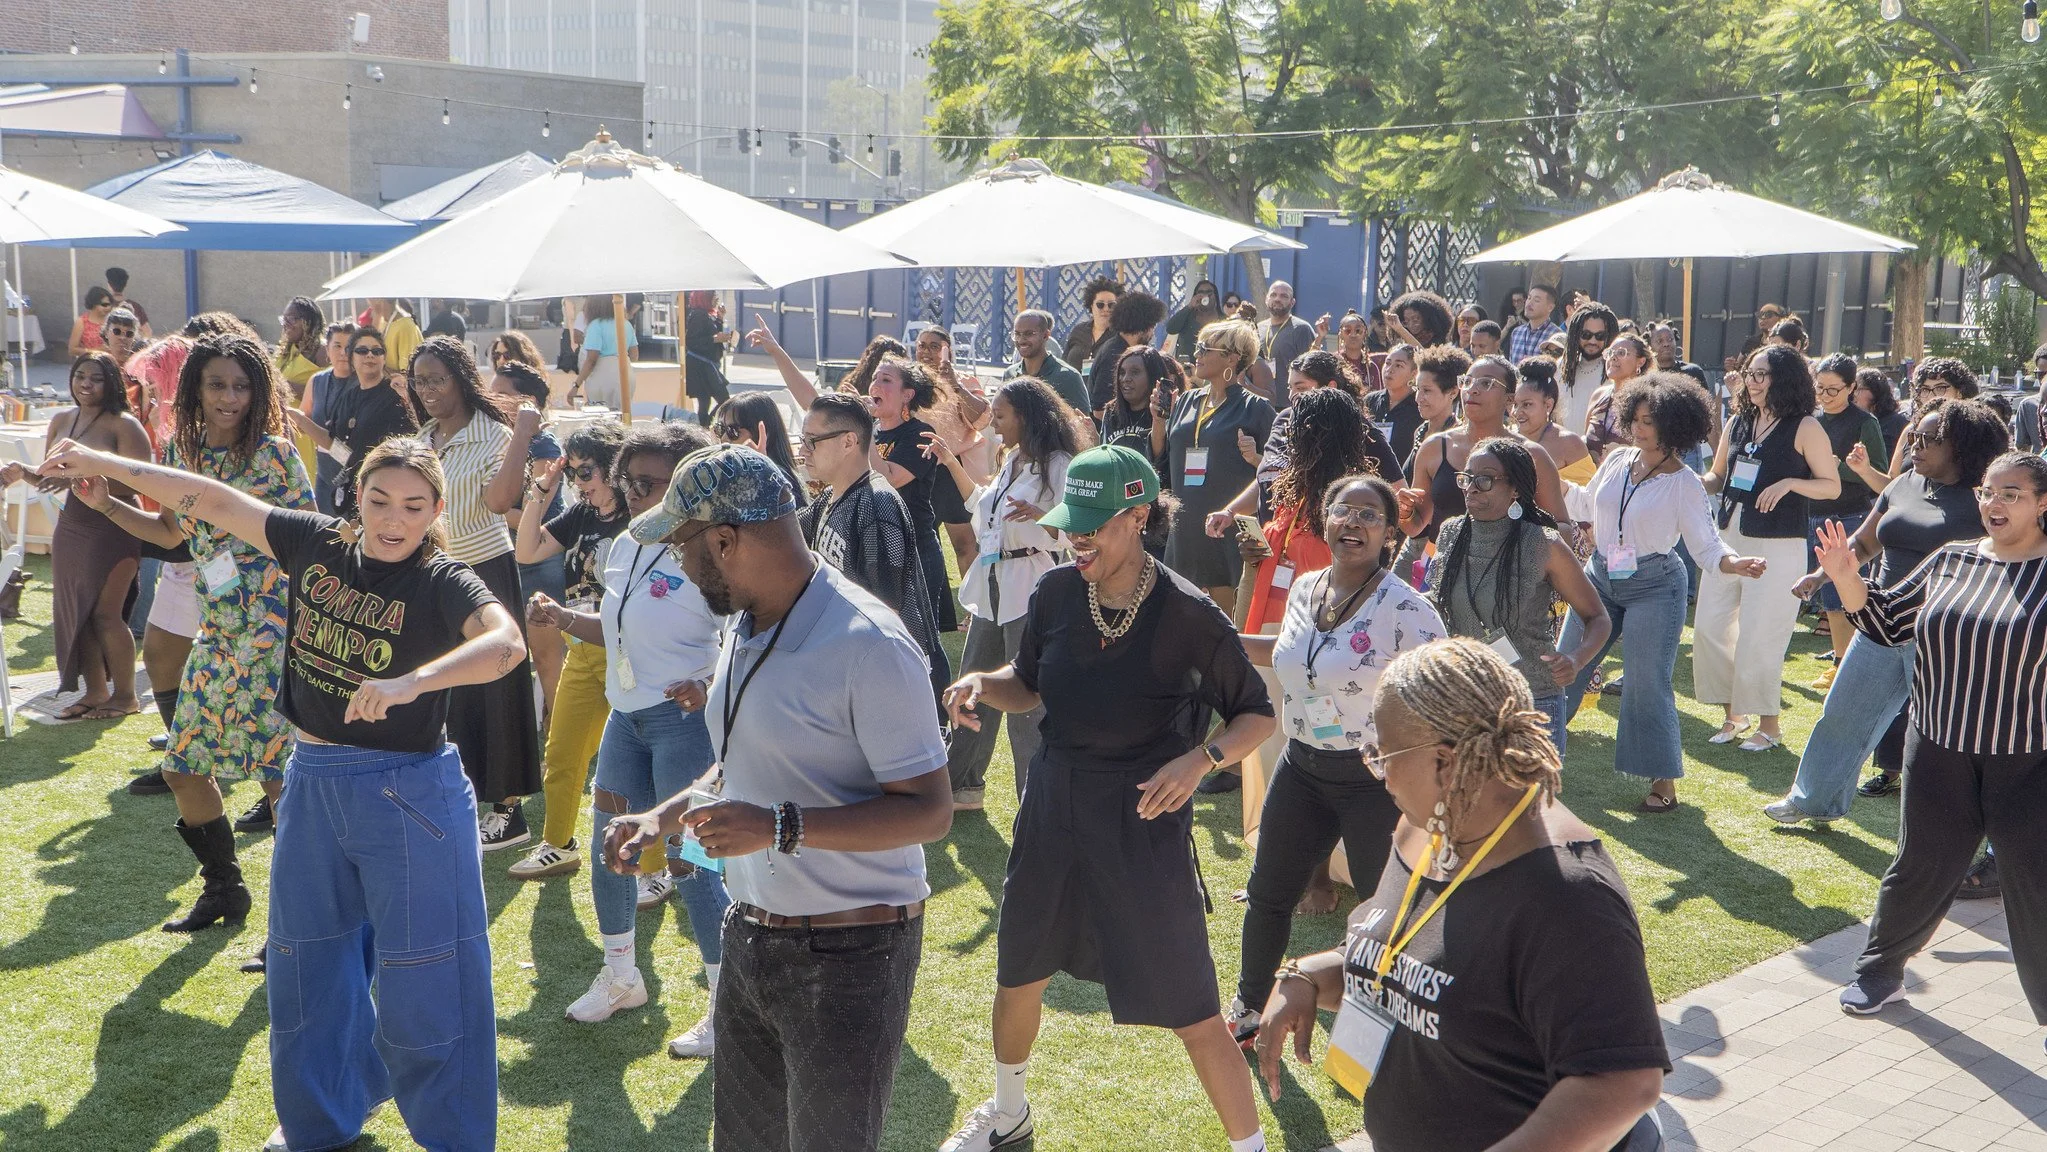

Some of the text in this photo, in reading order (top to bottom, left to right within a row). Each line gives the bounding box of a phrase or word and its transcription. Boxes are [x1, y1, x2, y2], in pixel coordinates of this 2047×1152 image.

[1285, 213, 1300, 224] EXIT
[676, 451, 766, 512] LOVE
[1085, 480, 1104, 490] MAKE
[1078, 488, 1098, 498] GREAT
[307, 674, 335, 694] DANCE
[337, 686, 356, 700] THE
[1386, 988, 1440, 1040] DREAMS
